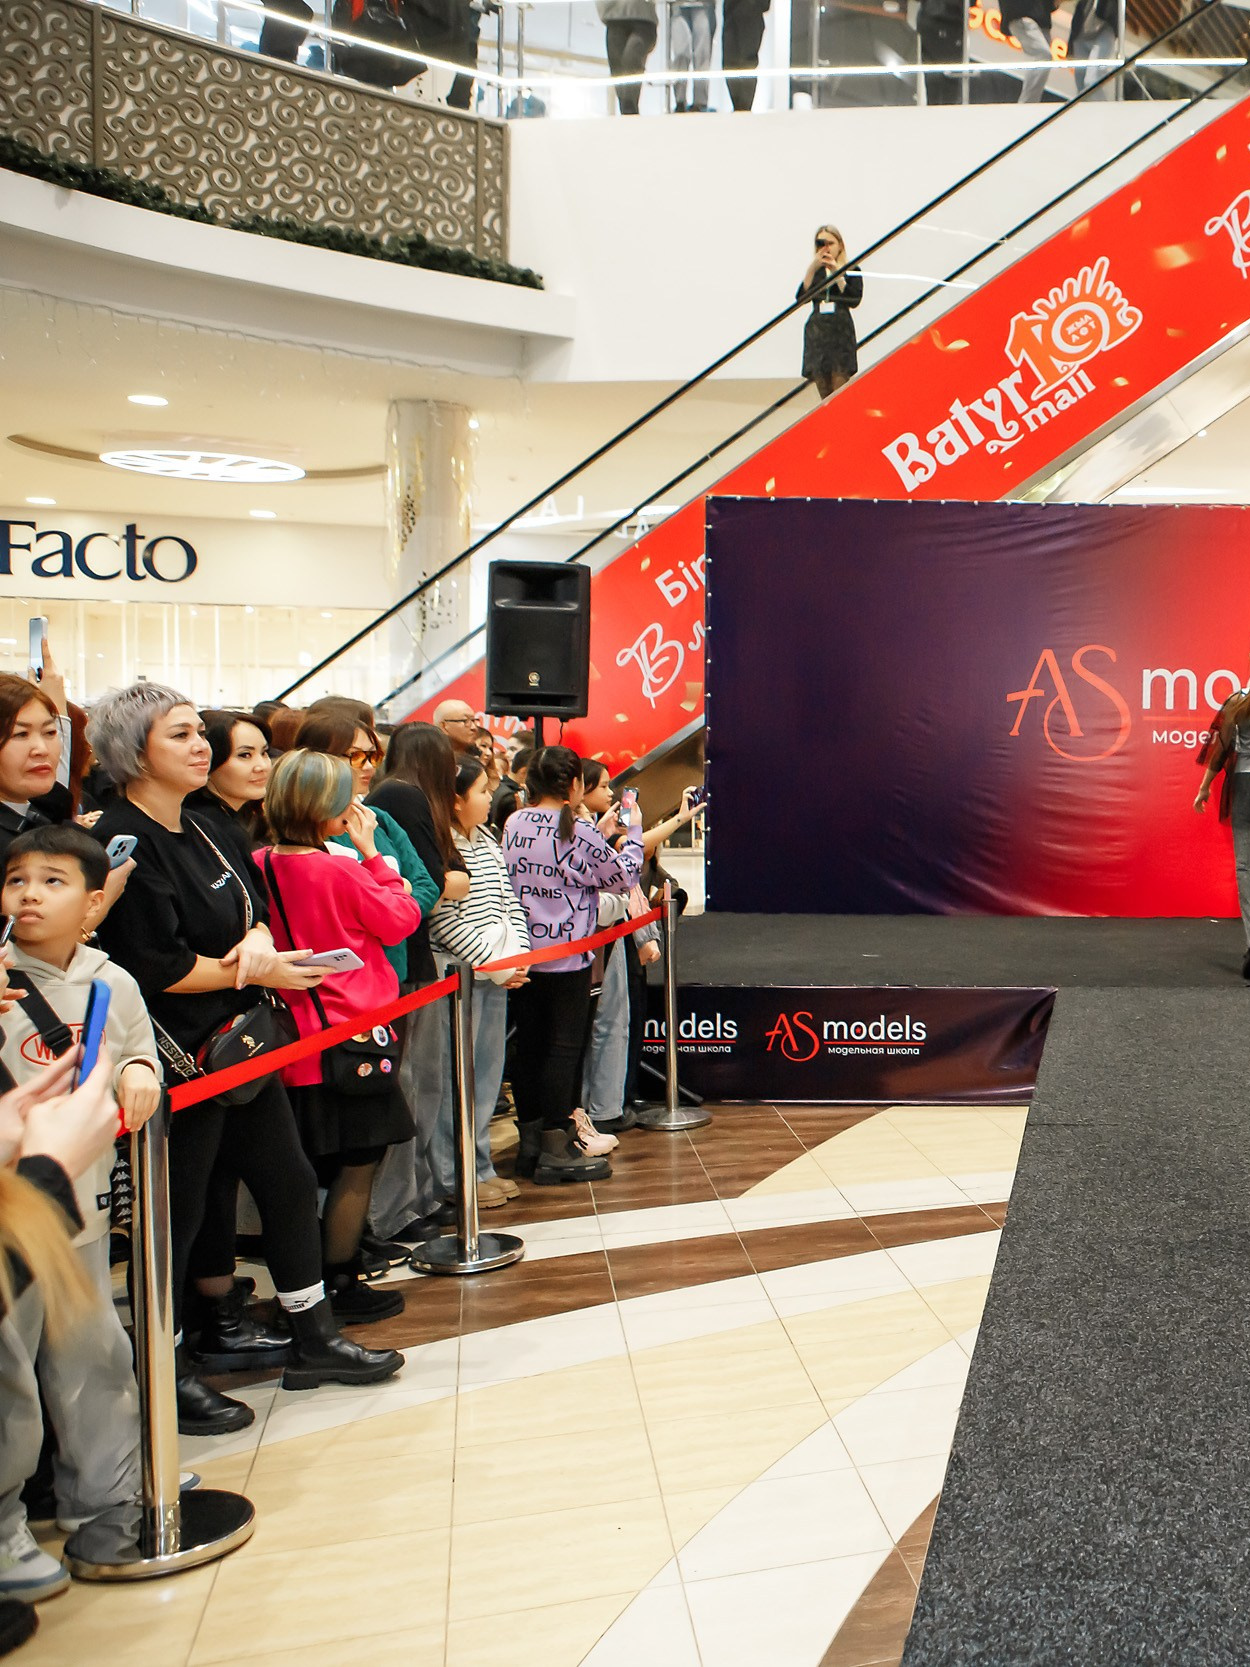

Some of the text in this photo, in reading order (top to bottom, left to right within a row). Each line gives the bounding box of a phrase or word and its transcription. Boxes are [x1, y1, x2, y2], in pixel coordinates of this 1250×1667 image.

[1021, 369, 1097, 433] mall
[881, 370, 1029, 493] Batyr
[0, 519, 198, 583] Facto
[1006, 644, 1132, 763] AS
[520, 885, 562, 900] PARIS
[698, 1045, 731, 1053] школа
[765, 1011, 927, 1062] AS models
[828, 1046, 920, 1056] модельная школа
